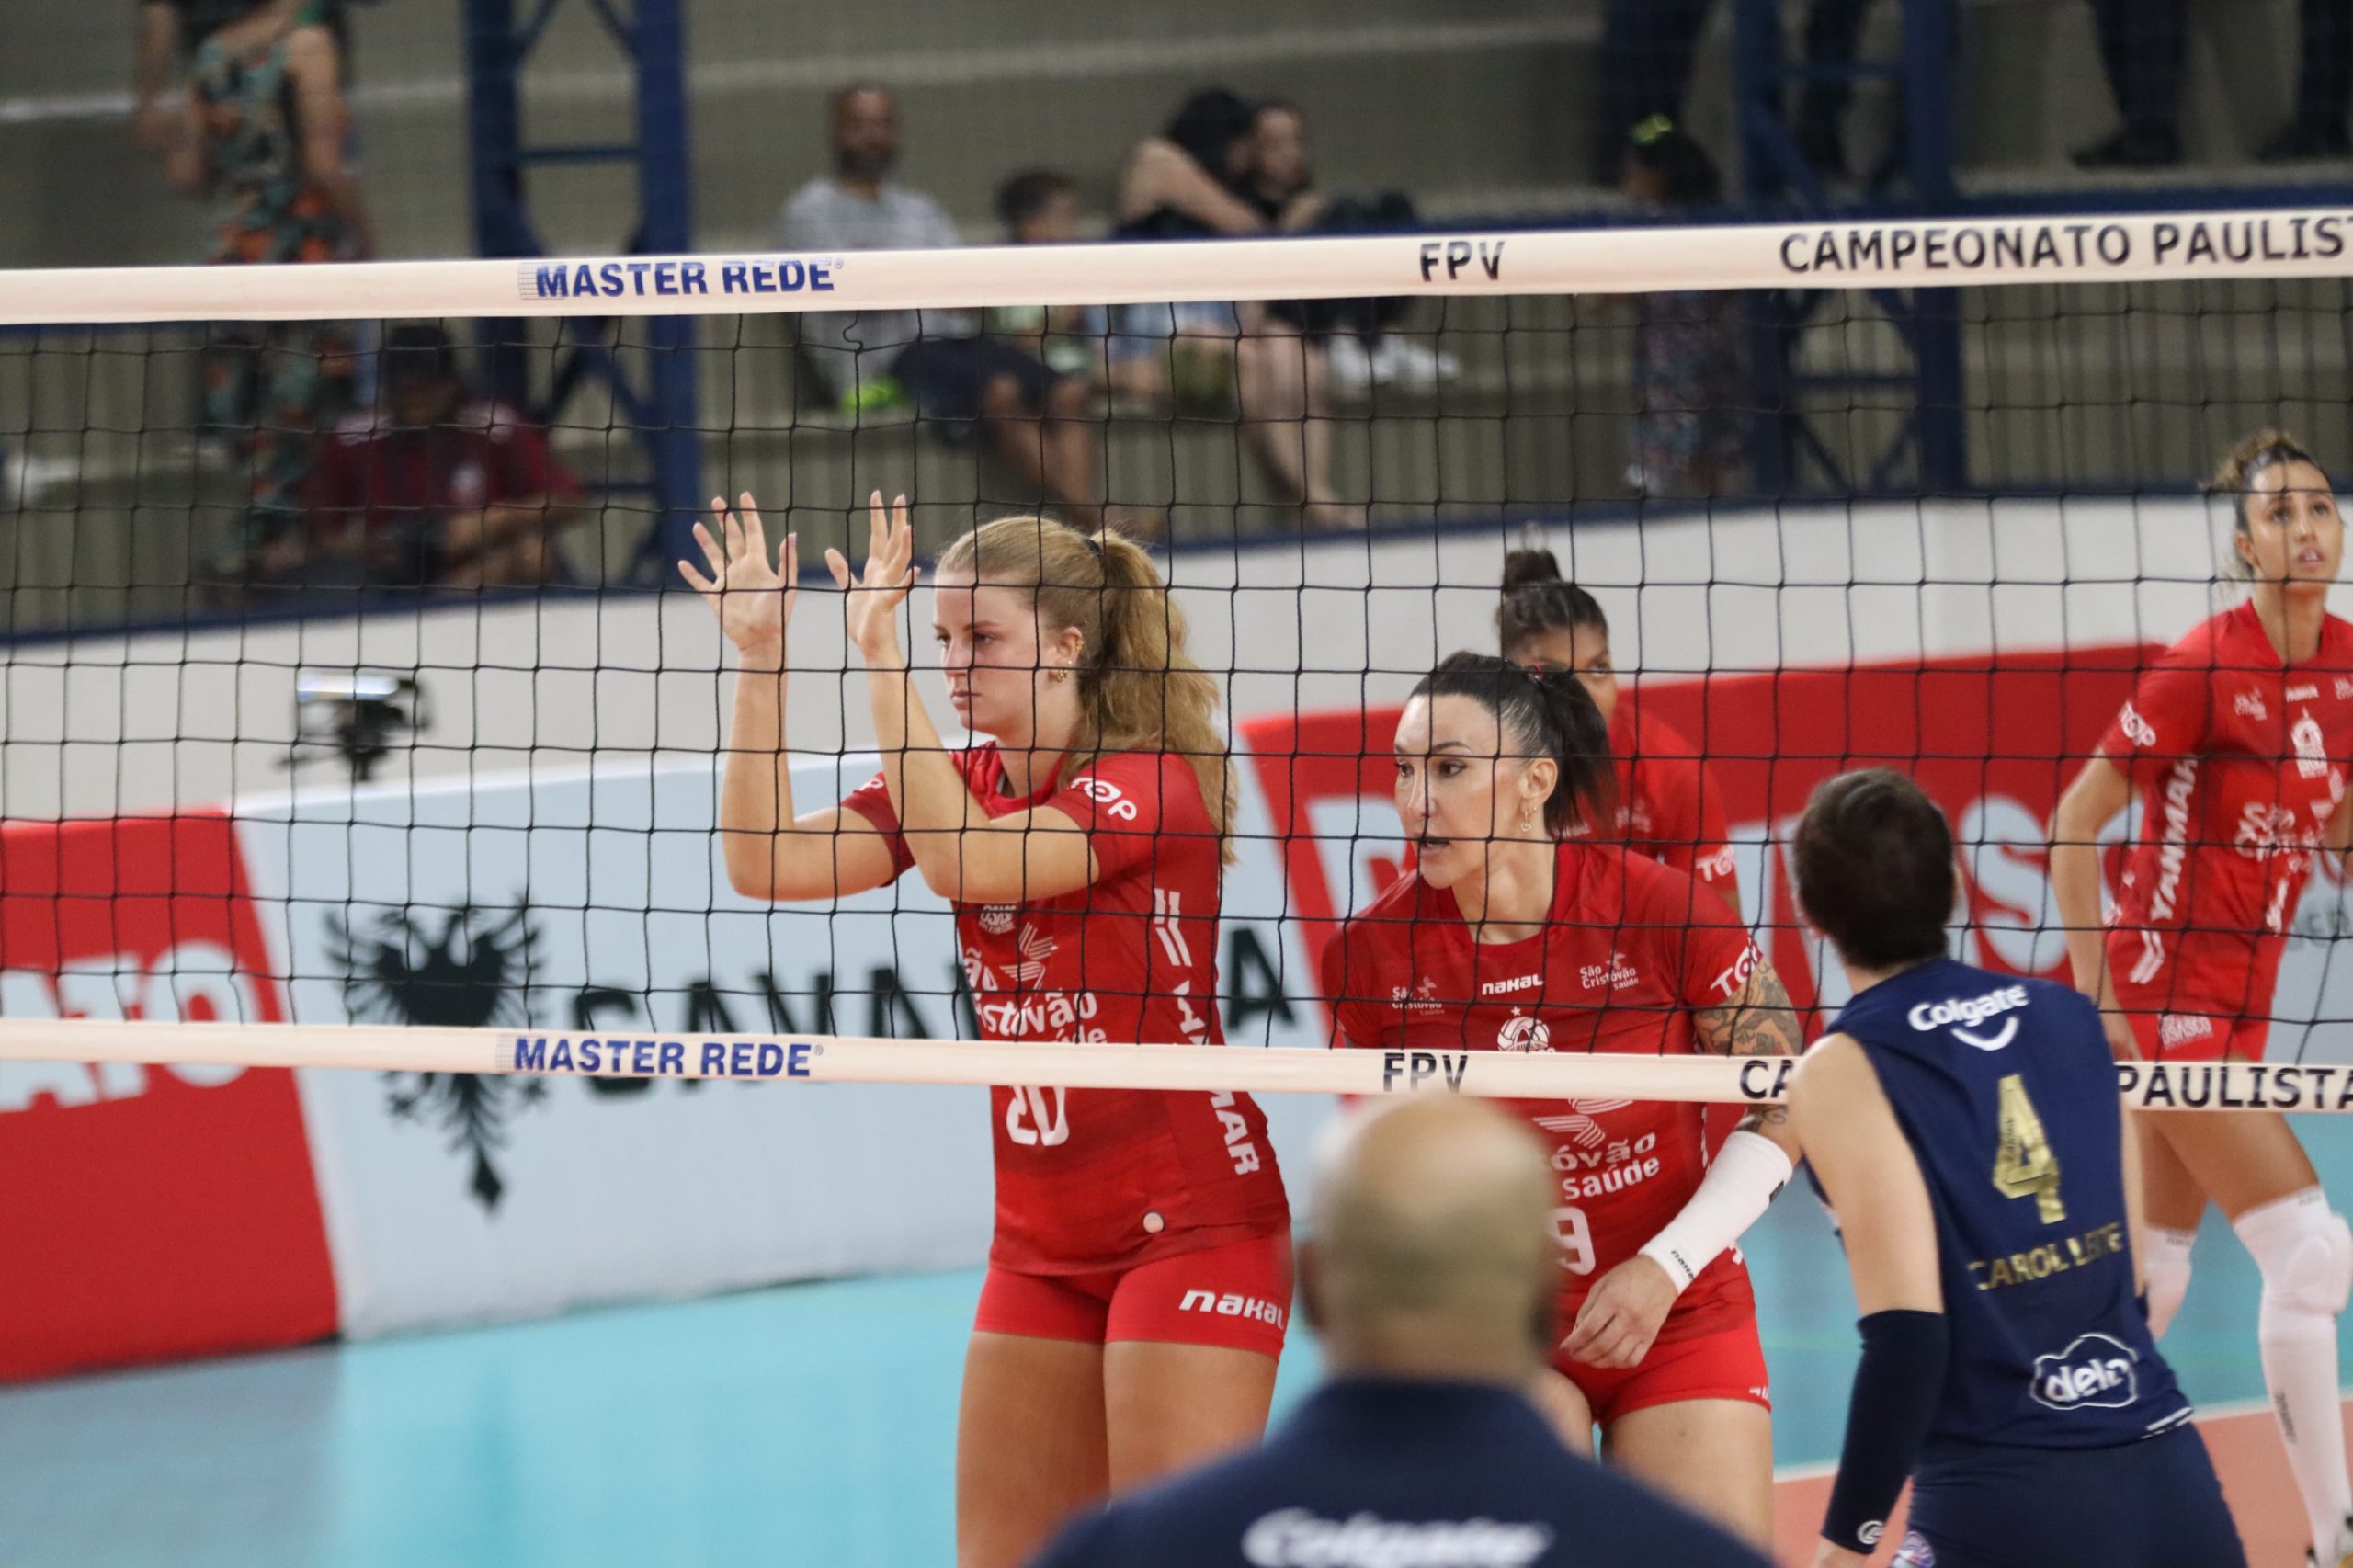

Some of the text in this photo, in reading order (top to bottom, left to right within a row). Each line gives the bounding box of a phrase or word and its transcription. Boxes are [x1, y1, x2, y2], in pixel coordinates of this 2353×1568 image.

[1420, 240, 1506, 282] FPV
[1780, 216, 2353, 273] CAMPEONATO PAULIS
[536, 261, 709, 298] MASTER
[1907, 983, 2030, 1031] Colgate
[514, 1037, 684, 1074] MASTER
[1383, 1052, 1469, 1094] FPV
[1993, 1073, 2067, 1225] 4
[1562, 1155, 1661, 1201] saúde
